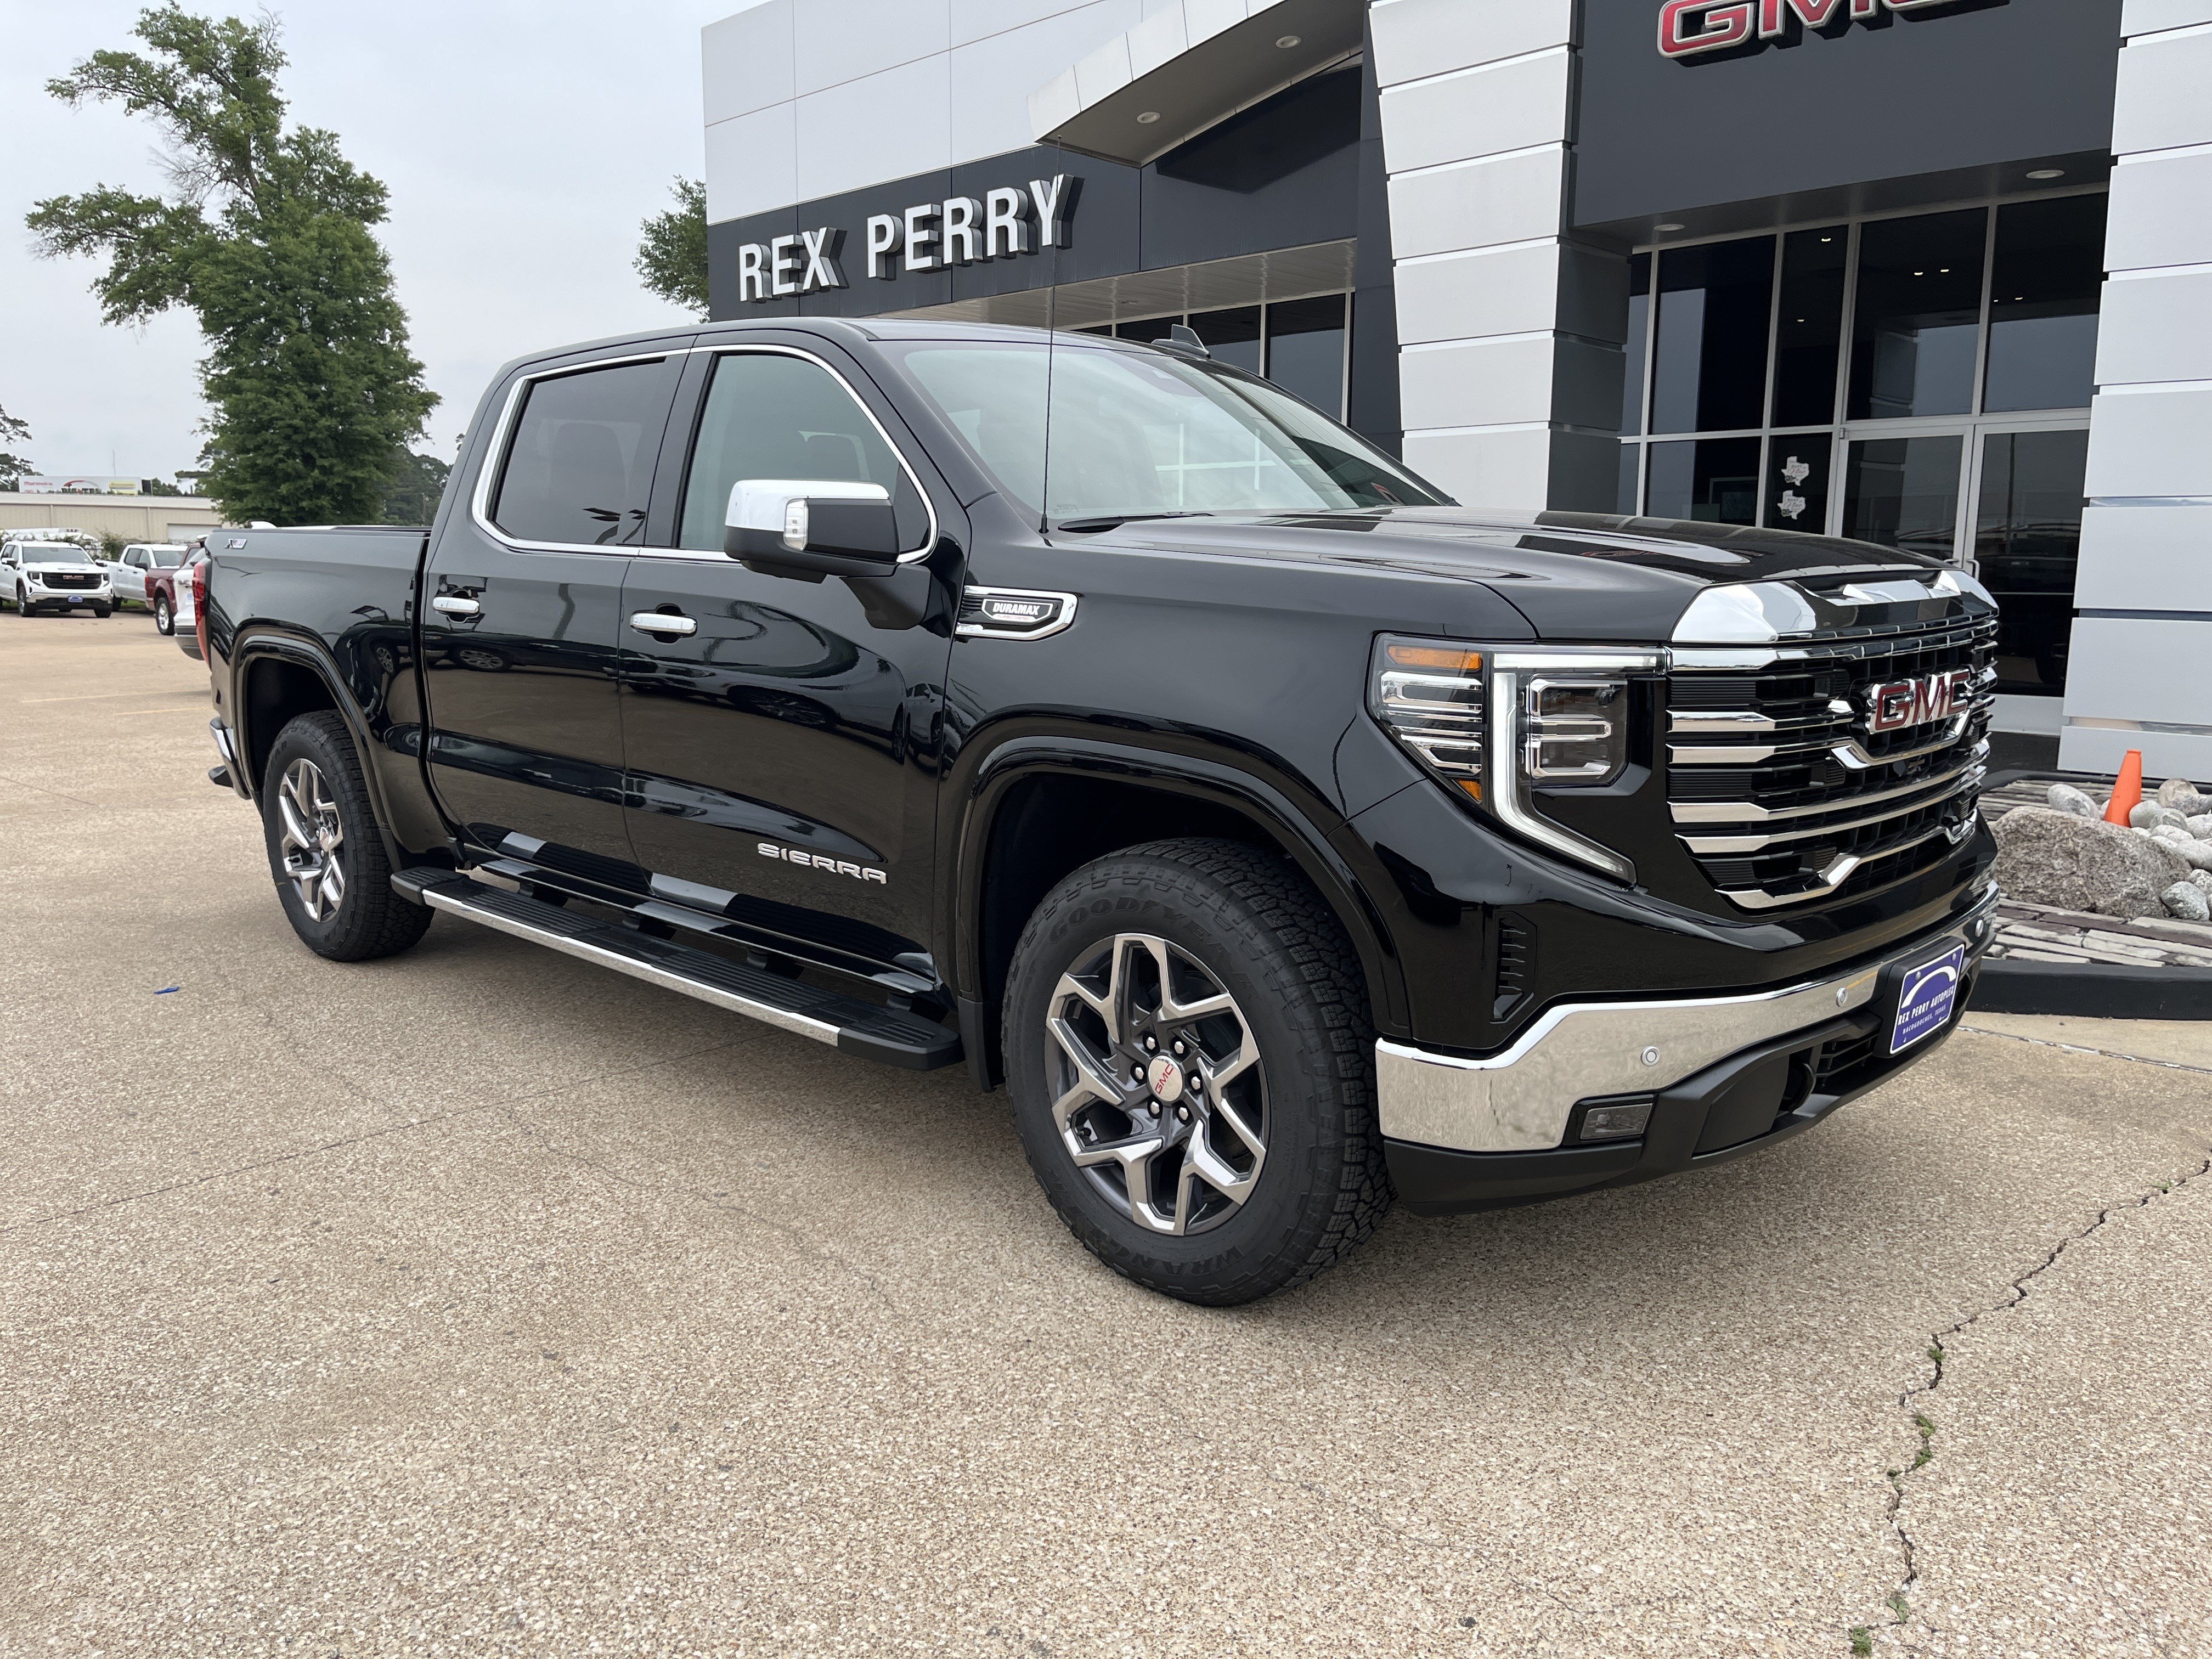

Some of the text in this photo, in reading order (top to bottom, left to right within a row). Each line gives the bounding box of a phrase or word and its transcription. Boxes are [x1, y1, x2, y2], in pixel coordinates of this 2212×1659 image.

[1657, 0, 1961, 58] GM
[738, 173, 1075, 302] REX PERRY
[992, 602, 1040, 616] DURAMAX
[1869, 668, 1971, 734] GMC
[757, 842, 888, 885] SIERRA
[1049, 898, 1261, 1001] GOODYEAR
[1898, 985, 1955, 1025] REX PERRY AUTOPLEX
[1155, 1063, 1174, 1094] GMC
